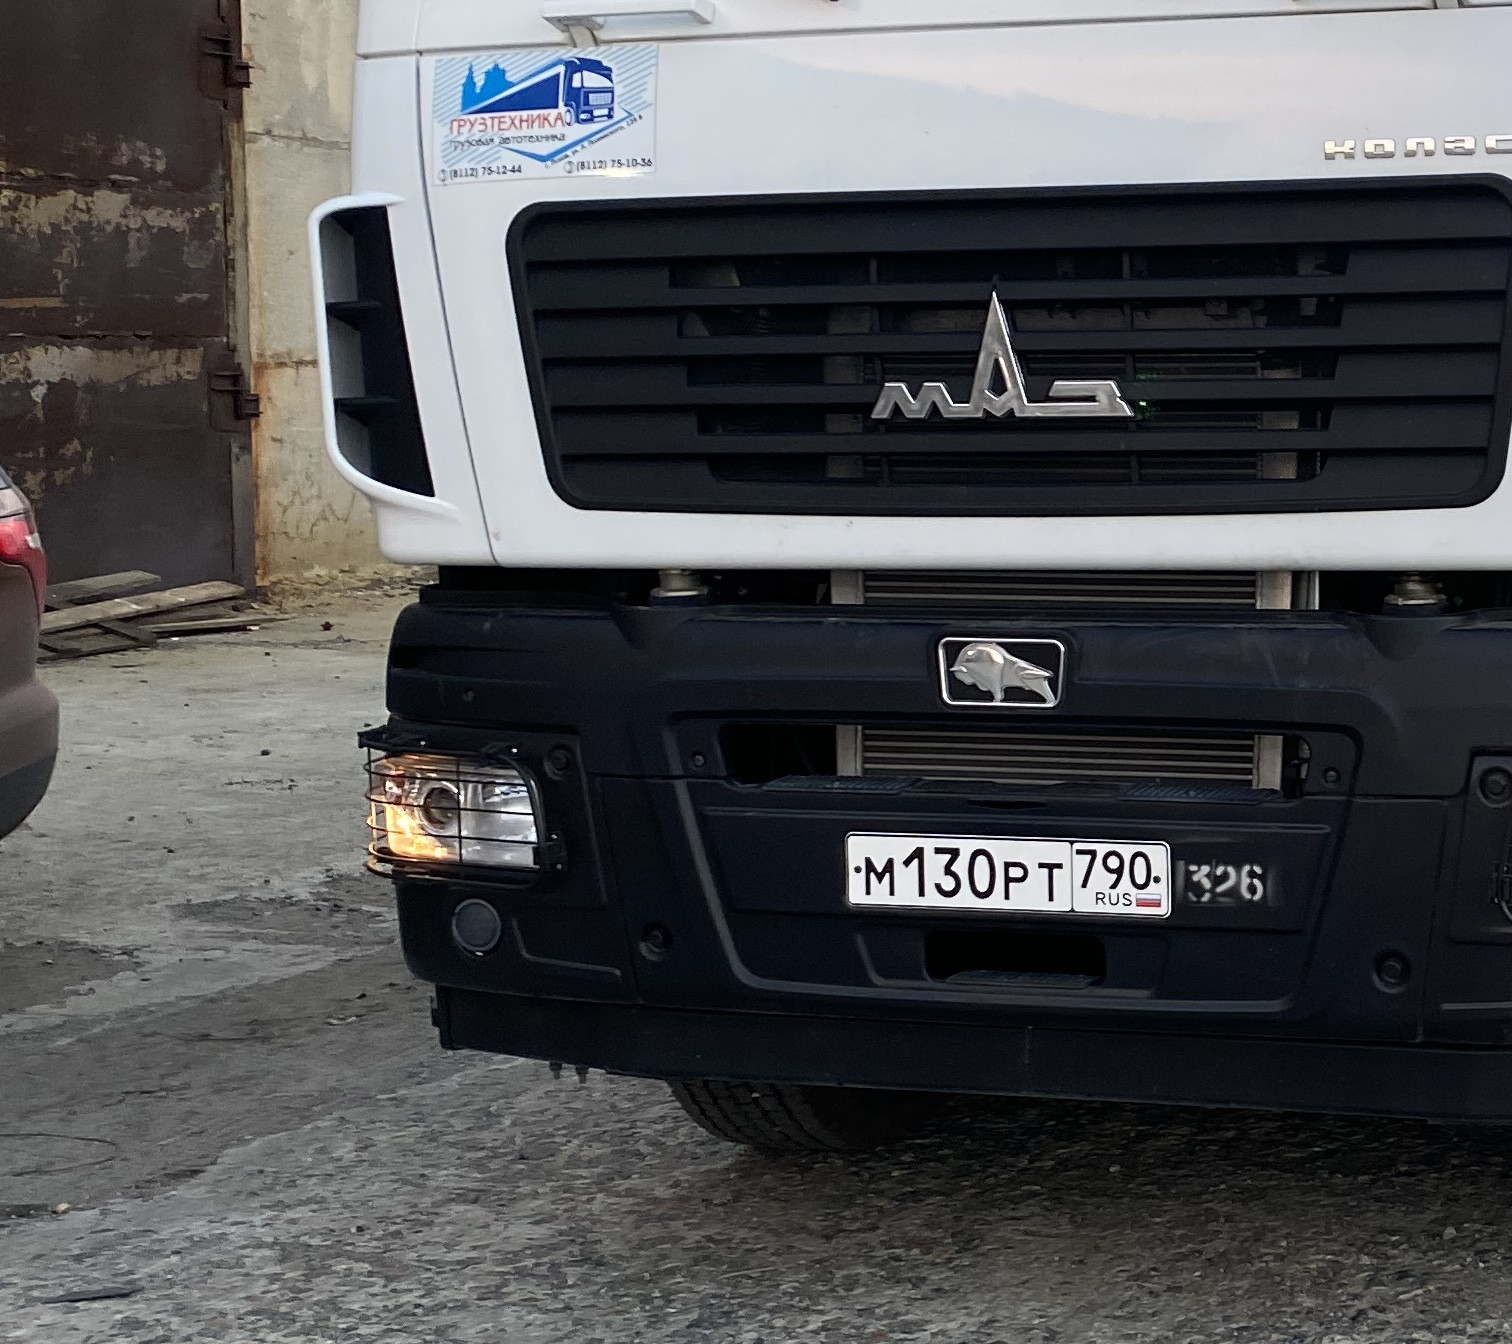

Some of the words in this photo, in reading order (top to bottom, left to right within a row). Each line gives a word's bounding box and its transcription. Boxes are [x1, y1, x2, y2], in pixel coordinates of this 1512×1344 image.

[449, 112, 566, 136] ГРУЗТЕХНИКА
[1075, 849, 1152, 891] 790
[1187, 864, 1264, 902] 326
[1095, 891, 1134, 907] RUS
